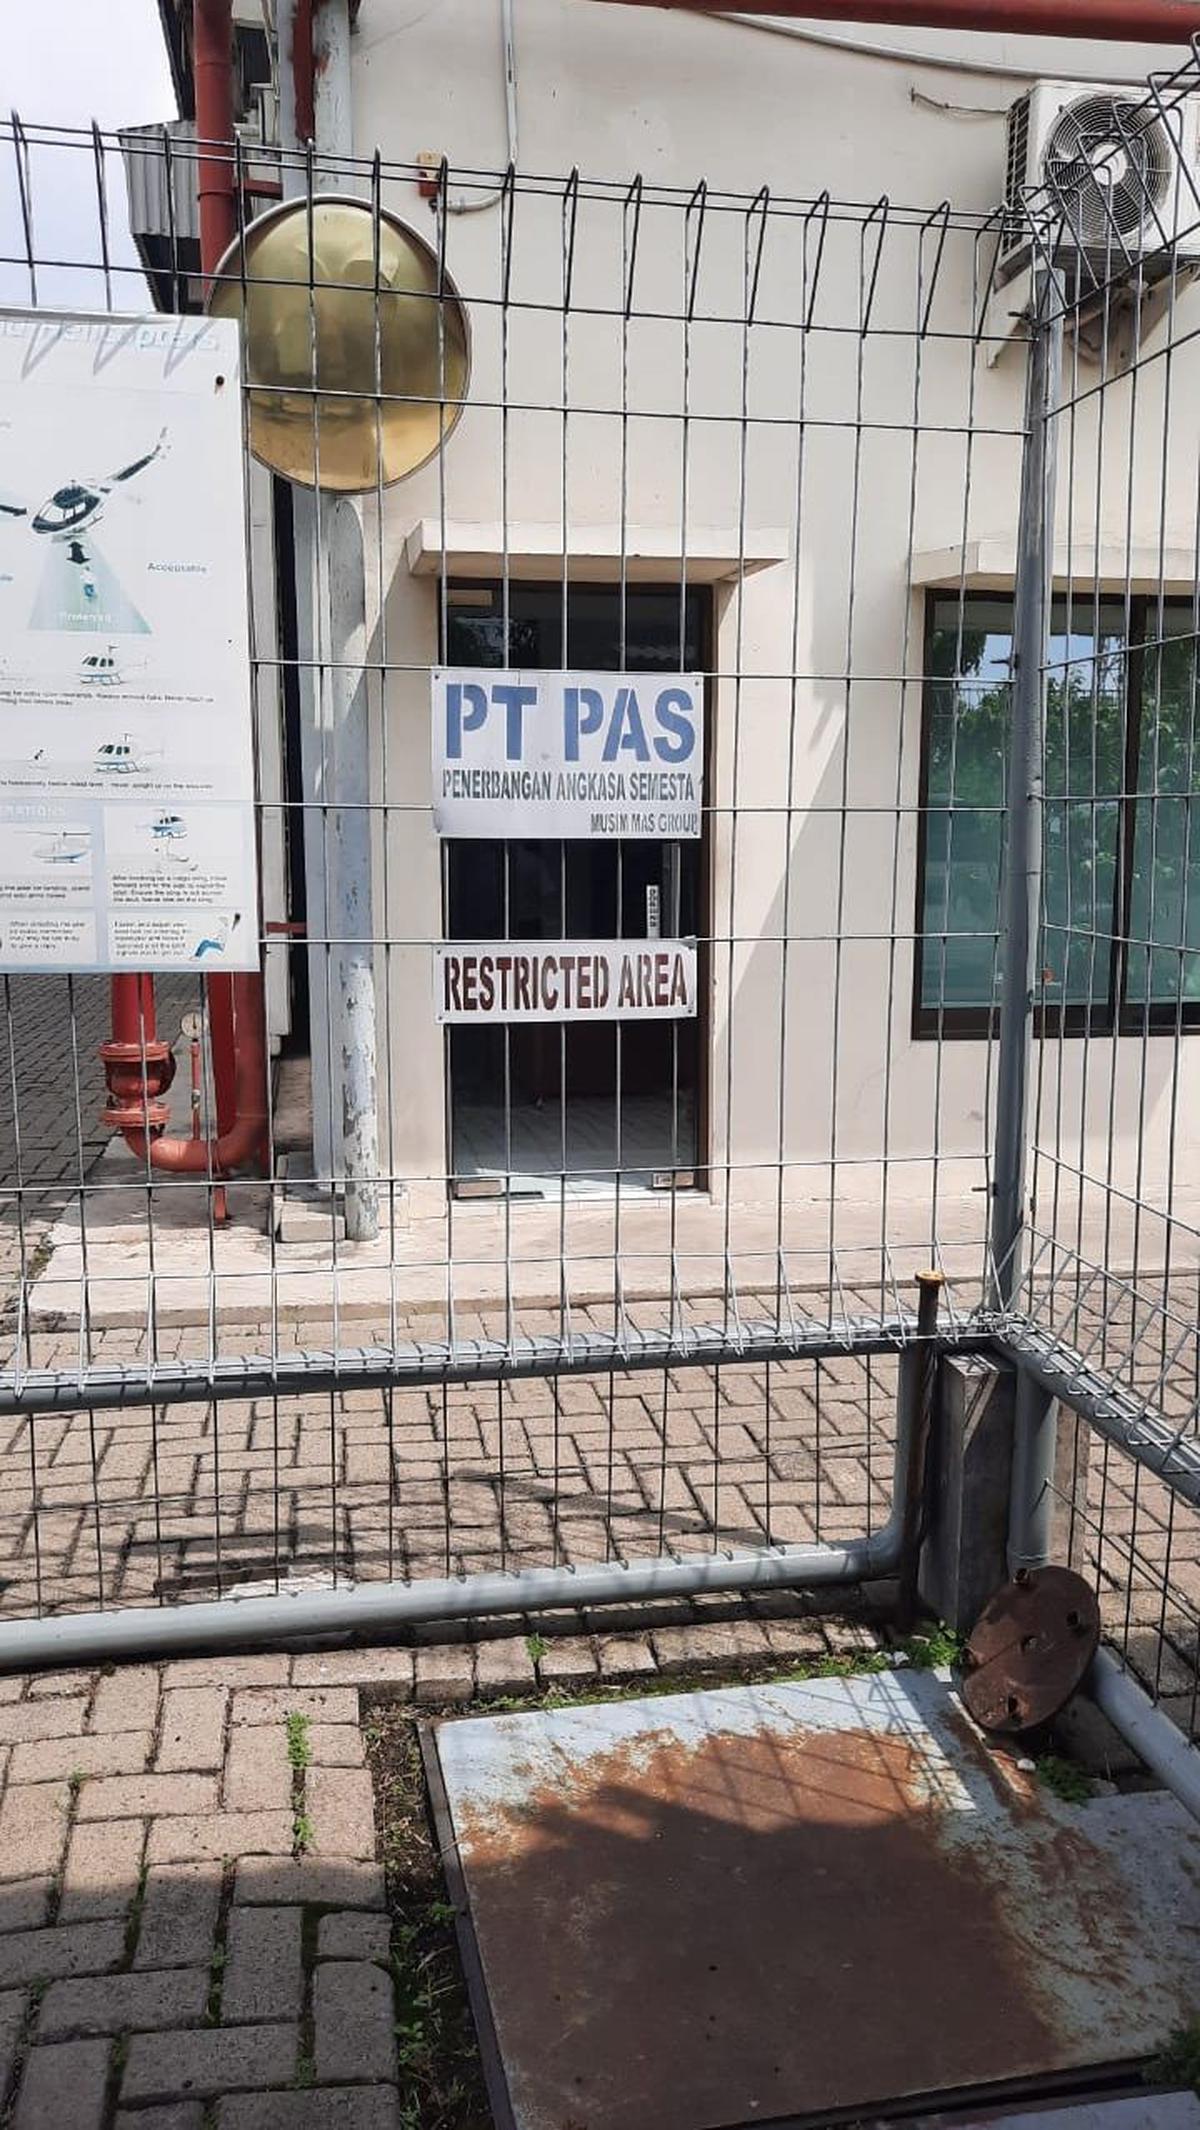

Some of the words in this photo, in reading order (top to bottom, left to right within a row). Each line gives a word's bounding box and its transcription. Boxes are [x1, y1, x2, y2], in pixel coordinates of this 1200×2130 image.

[446, 683, 537, 761] PT
[564, 688, 696, 763] PAS
[443, 769, 551, 801] PENERBANGAN
[557, 771, 627, 801] ANGKASA
[630, 773, 694, 801] SEMESTA
[631, 813, 655, 833] MAS
[658, 813, 698, 833] GROUP
[444, 954, 609, 1011] RESTRICTED
[618, 953, 688, 1008] AREA
